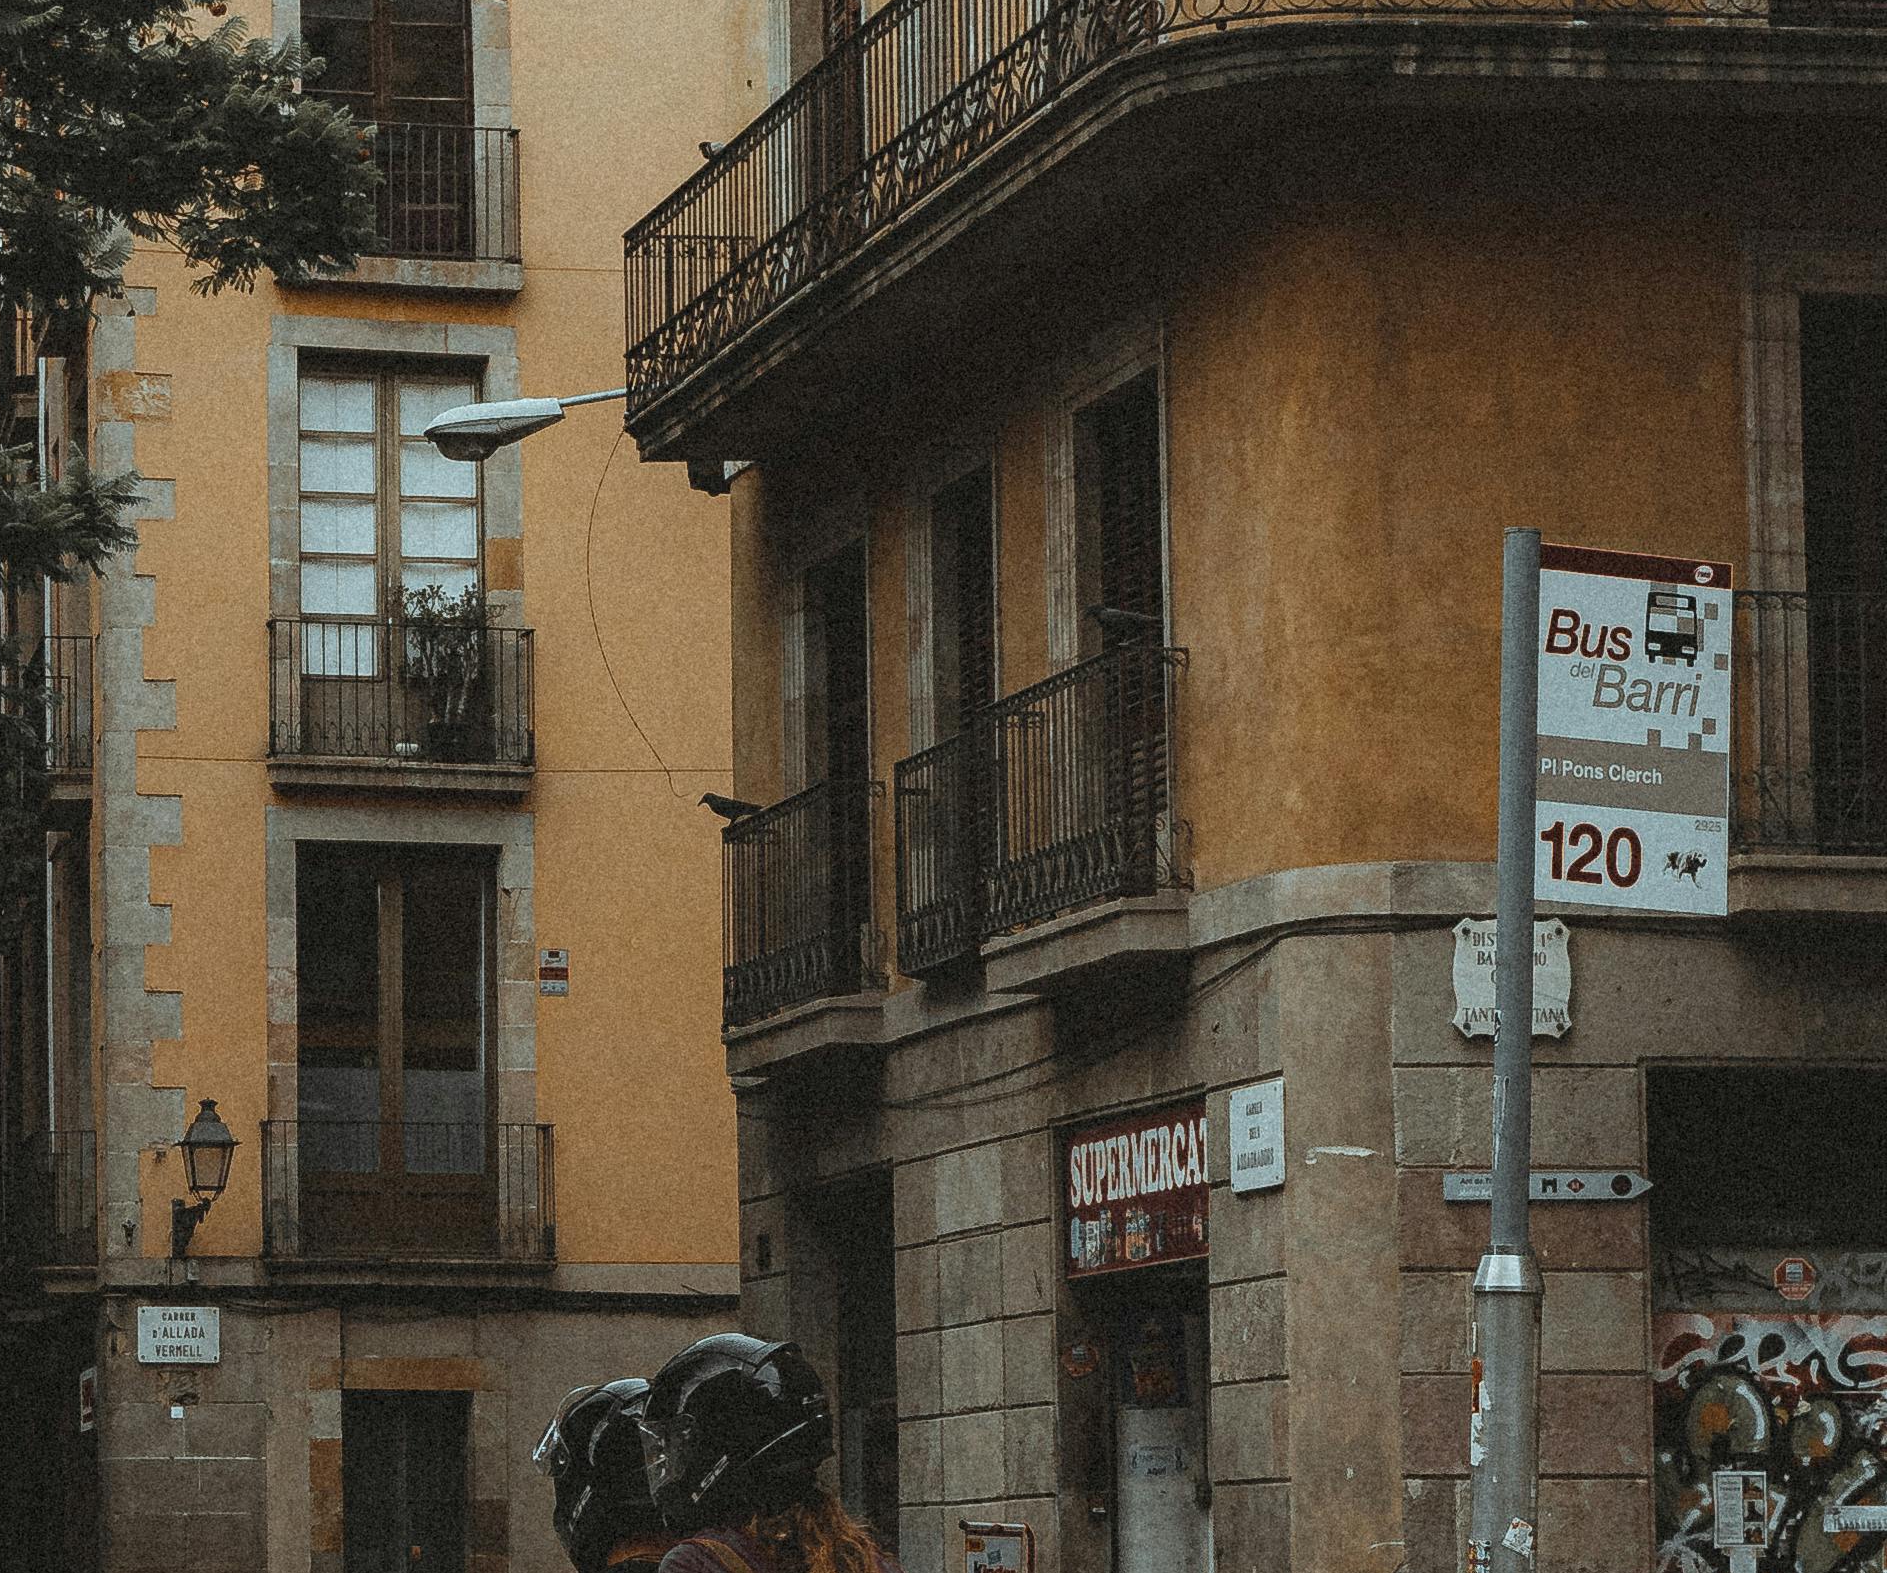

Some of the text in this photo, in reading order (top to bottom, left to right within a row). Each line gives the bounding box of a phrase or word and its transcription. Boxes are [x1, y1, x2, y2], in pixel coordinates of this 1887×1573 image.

[1545, 608, 1632, 661] Bus
[1570, 662, 1702, 717] del Barri
[1562, 760, 1603, 780] Pons
[1609, 765, 1662, 785] Clerch
[1540, 821, 1642, 888] 120
[162, 1313, 196, 1321] CARRER
[155, 1345, 202, 1357] VERMELL
